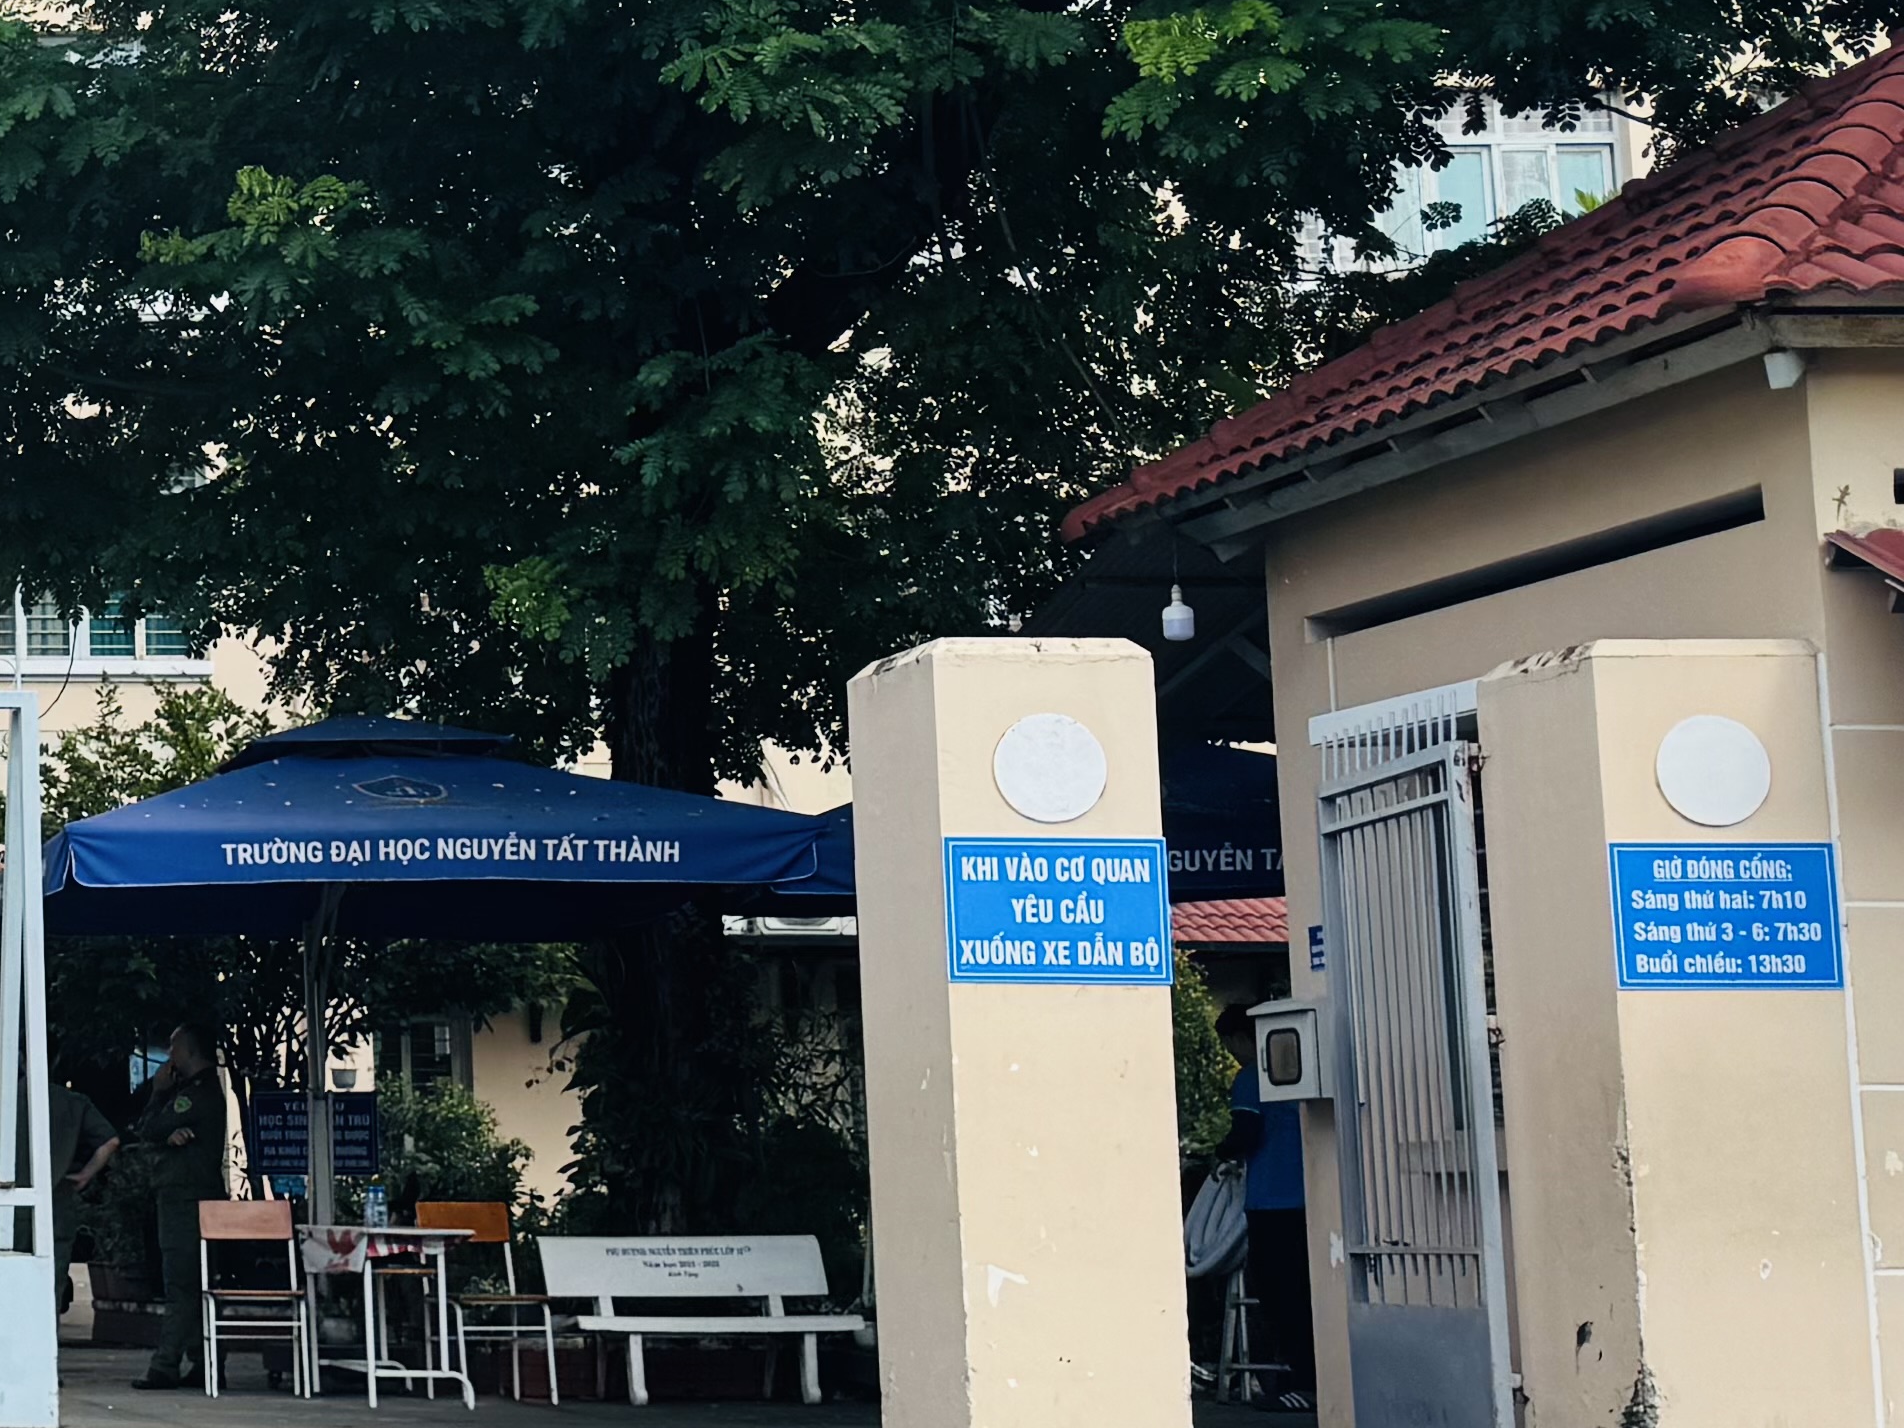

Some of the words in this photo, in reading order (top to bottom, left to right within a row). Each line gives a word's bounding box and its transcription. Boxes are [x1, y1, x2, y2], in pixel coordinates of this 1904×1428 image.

[221, 837, 323, 866] TRƯỜNG
[330, 839, 371, 866] ĐẠI
[379, 838, 430, 865] HỌC
[437, 831, 536, 861] NGUYỄN
[542, 833, 589, 861] TẤT
[593, 835, 680, 863] THÀNH
[1168, 841, 1253, 872] GUYỄN
[961, 856, 999, 881] KHI
[1004, 852, 1048, 882] VÀO
[1055, 855, 1085, 882] CƠ
[1092, 857, 1150, 885] QUAN
[1653, 855, 1683, 880] GIỜ
[1687, 856, 1734, 880] ĐÓNG
[1011, 893, 1053, 923] YÊU
[1631, 890, 1679, 912] Sáng
[1684, 890, 1714, 909] thứ
[1719, 890, 1755, 910] hai:
[1759, 890, 1807, 910] 7h10
[1633, 921, 1681, 944] Sáng
[1686, 921, 1716, 942] thứ
[1721, 922, 1733, 942] 3
[1752, 922, 1770, 942] 6:
[1774, 922, 1822, 942] 7h30
[960, 931, 1036, 965] XUỐNG
[1043, 941, 1071, 965] XE
[1077, 932, 1123, 966] DẪN
[1130, 936, 1160, 972] BỘ
[1636, 949, 1678, 973] Buổi
[1748, 954, 1806, 974] 13h30
